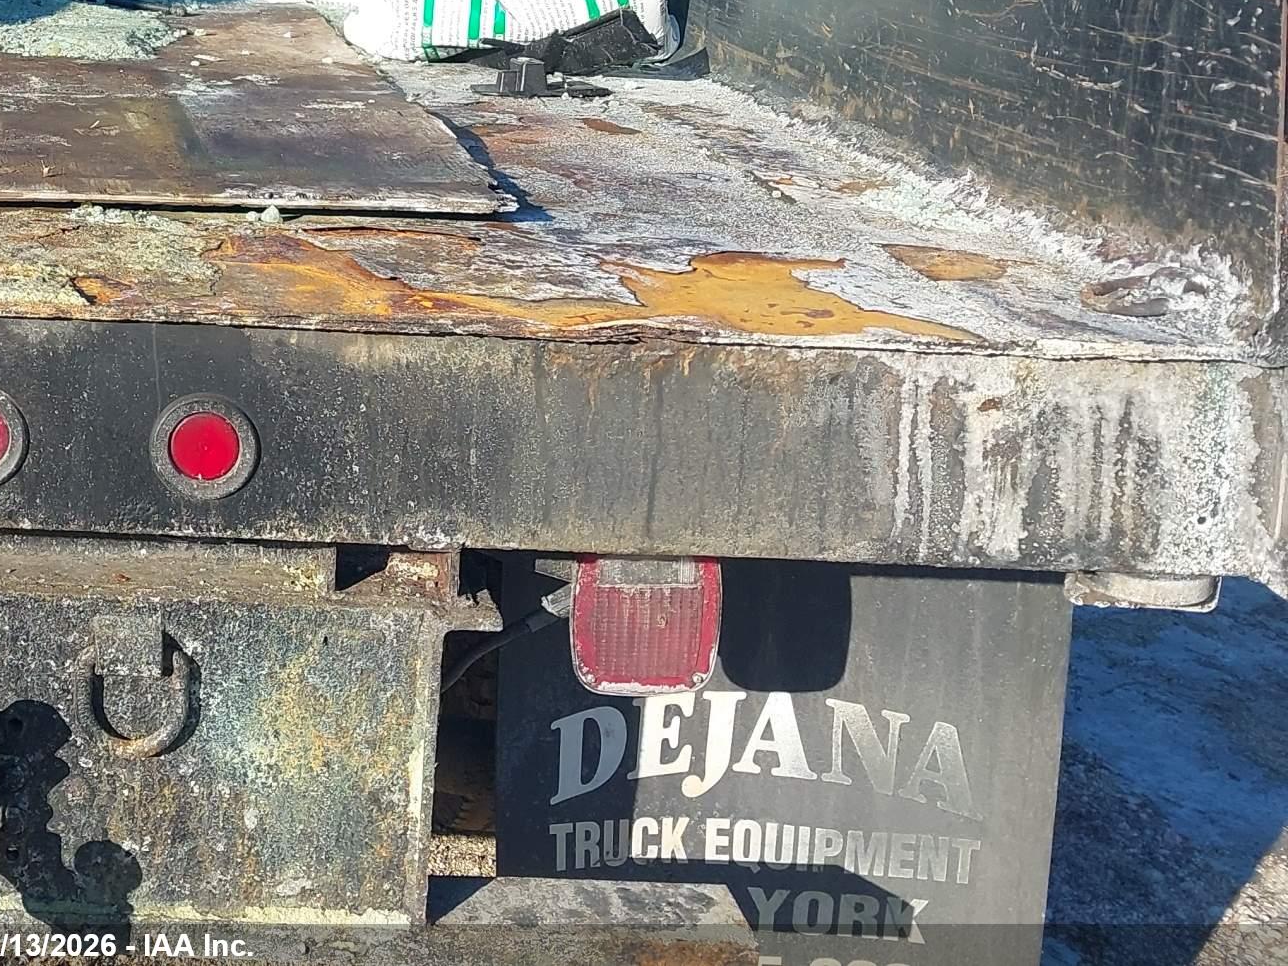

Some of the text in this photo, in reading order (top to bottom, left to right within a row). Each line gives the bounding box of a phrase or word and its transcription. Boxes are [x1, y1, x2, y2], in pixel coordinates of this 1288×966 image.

[549, 690, 985, 822] DEJANA
[549, 816, 982, 885] TRUCK EQUIPMENT
[747, 886, 930, 945] YORK
